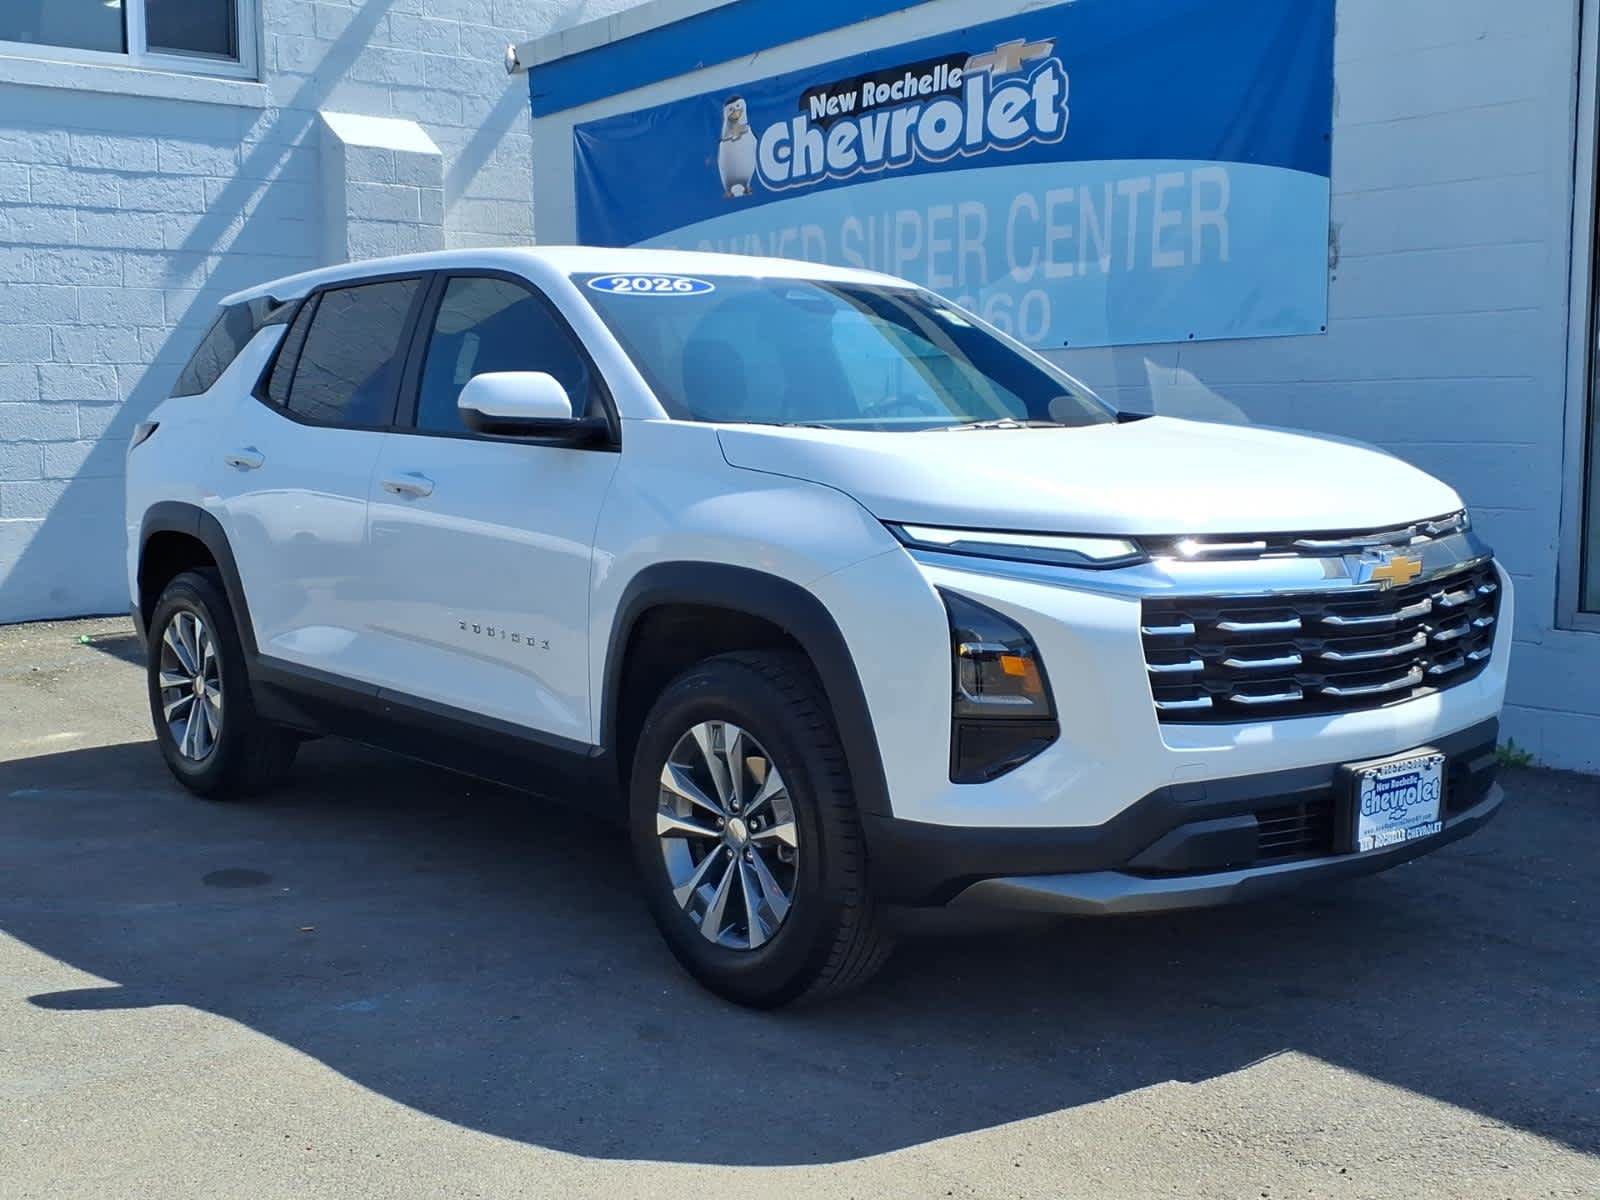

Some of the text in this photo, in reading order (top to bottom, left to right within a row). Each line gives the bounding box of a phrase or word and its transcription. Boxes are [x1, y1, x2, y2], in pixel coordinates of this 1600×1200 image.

[808, 63, 963, 120] New Rochelle
[758, 65, 1060, 183] Chevrolet
[840, 165, 1231, 290] SUPER CENTER
[611, 278, 693, 292] 2026
[953, 289, 1051, 344] 60
[1361, 777, 1441, 817] Chevrolet
